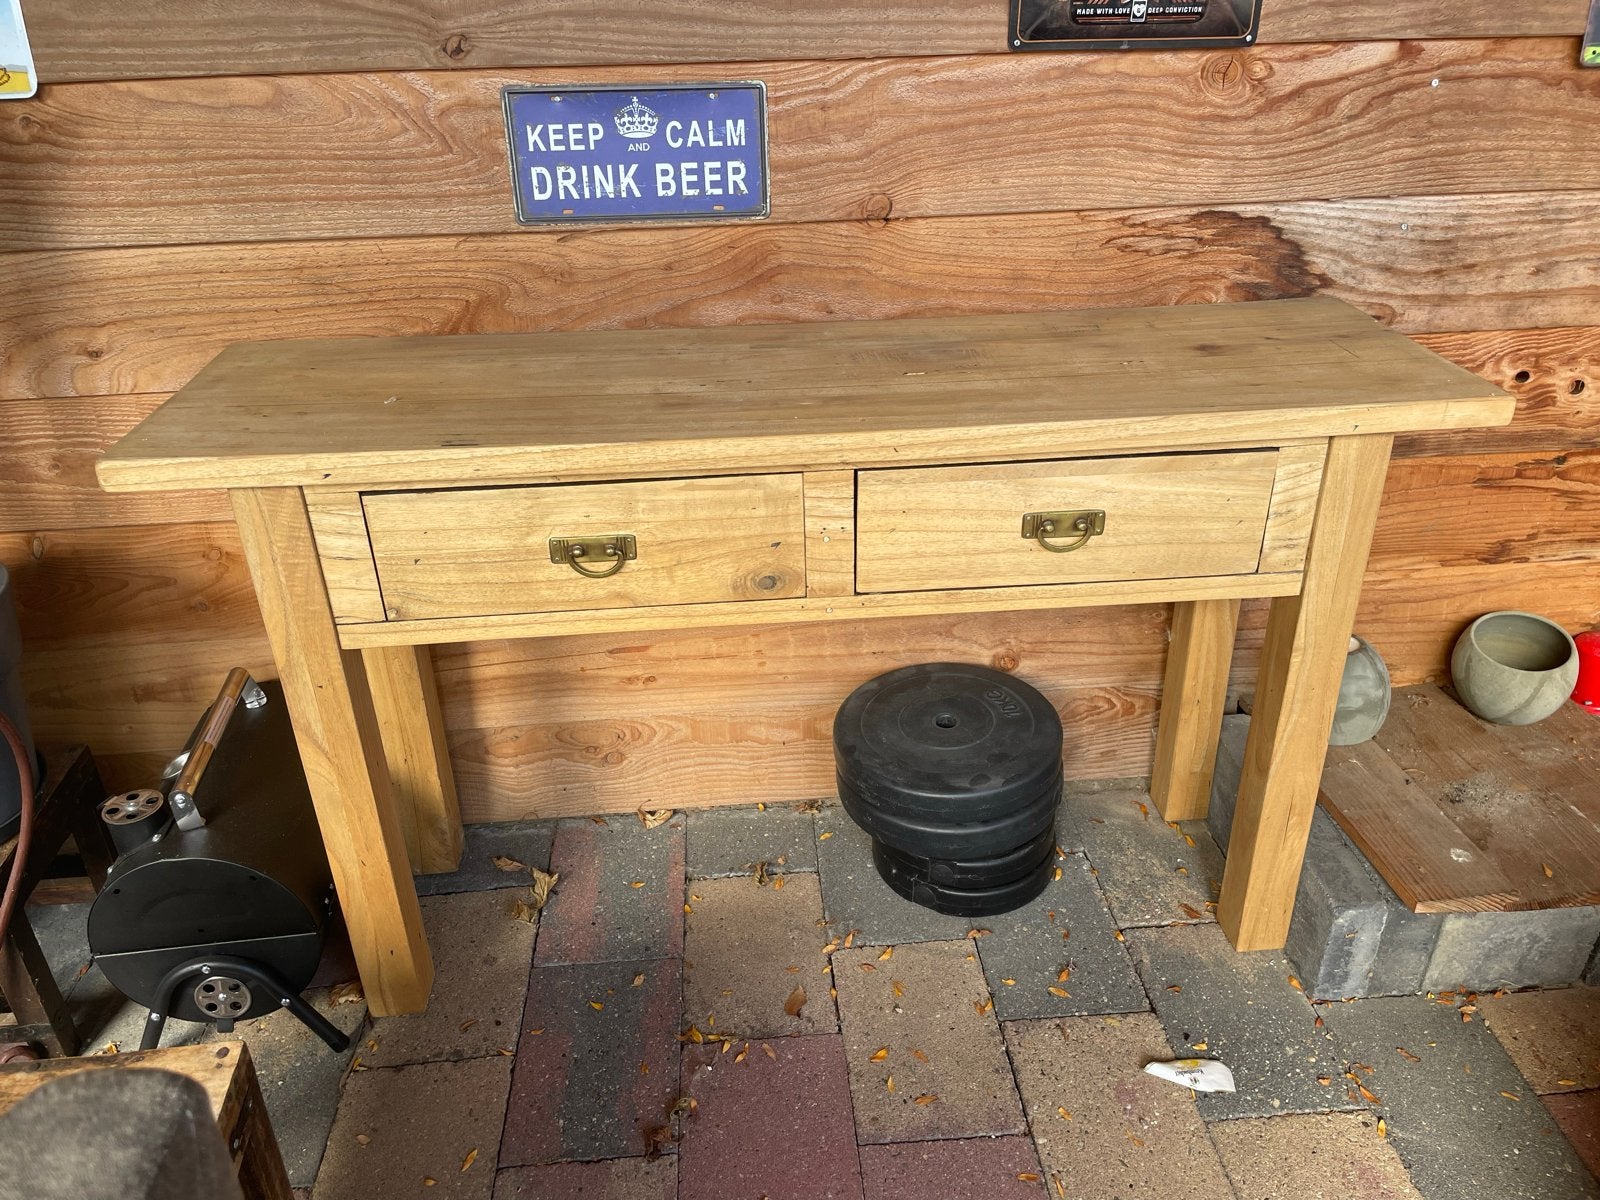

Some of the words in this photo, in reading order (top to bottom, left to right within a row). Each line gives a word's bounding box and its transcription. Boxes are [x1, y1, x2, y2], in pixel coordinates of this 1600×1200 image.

[526, 123, 604, 152] KEEP
[665, 119, 746, 149] CALM
[627, 142, 650, 152] AND
[530, 163, 642, 201] DRINK
[655, 160, 749, 197] BEER
